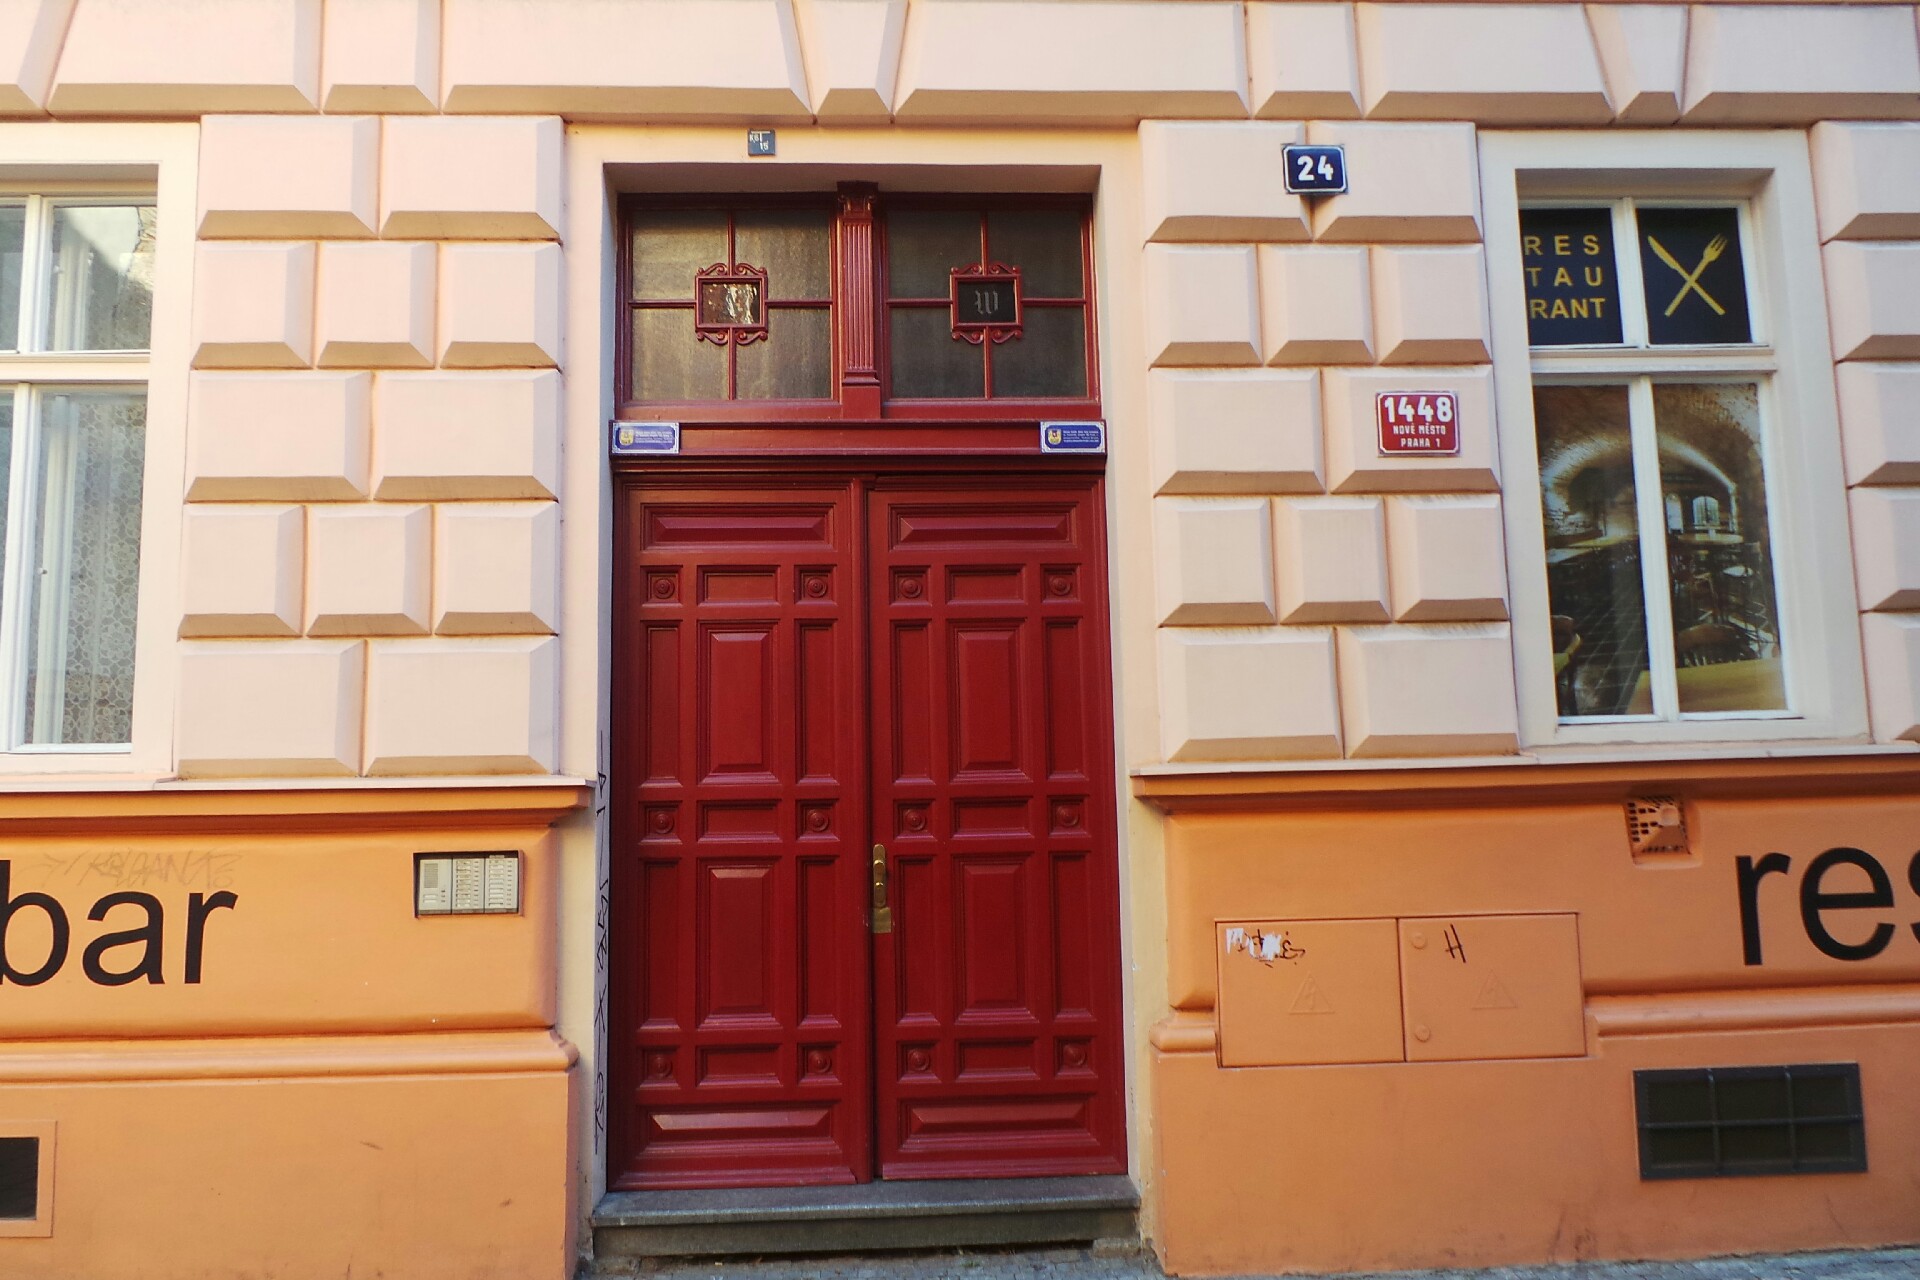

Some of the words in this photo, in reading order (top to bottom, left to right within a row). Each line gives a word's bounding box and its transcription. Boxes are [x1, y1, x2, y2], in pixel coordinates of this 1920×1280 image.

[1297, 155, 1334, 181] 24
[1524, 234, 1600, 256] RES
[1525, 266, 1603, 287] TAU
[1530, 298, 1606, 319] RANT
[1384, 396, 1453, 423] 1448
[1393, 423, 1416, 435] NOVÉ
[1418, 422, 1446, 435] MĚSTO
[1401, 438, 1430, 447] PRAHA
[1436, 438, 1441, 447] 1
[1735, 846, 1920, 966] re
[0, 860, 239, 987] bar
